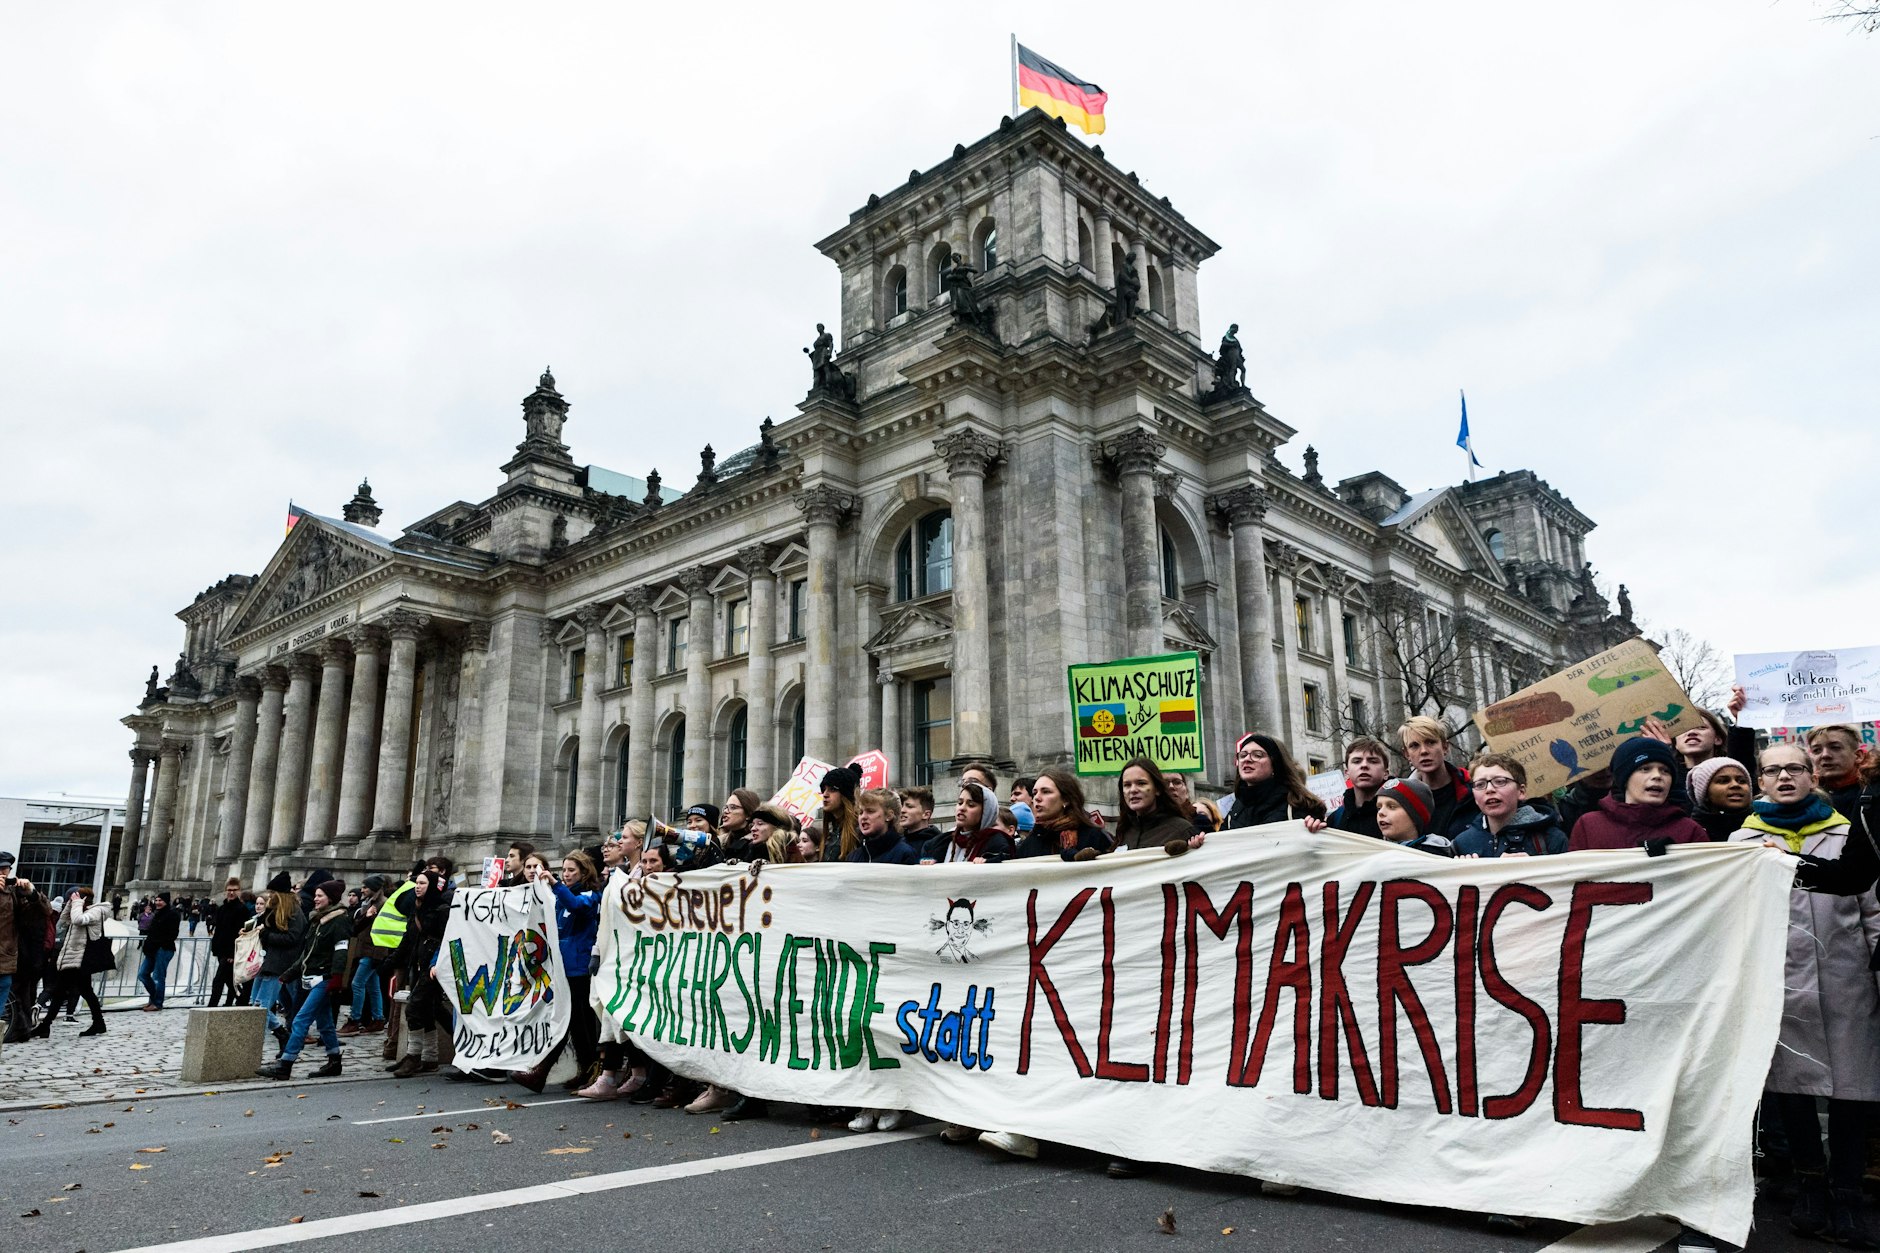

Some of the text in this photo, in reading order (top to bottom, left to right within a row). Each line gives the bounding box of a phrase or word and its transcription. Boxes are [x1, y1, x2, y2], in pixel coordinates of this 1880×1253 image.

[1566, 667, 1585, 681] DER
[1586, 651, 1619, 672] LETZTE
[1787, 670, 1838, 686] Ich kann
[1075, 668, 1195, 703] KLIMASCHUTZ
[1803, 687, 1827, 700] nicht
[1832, 684, 1867, 699] finden
[1127, 701, 1152, 726] ist
[1578, 727, 1615, 749] MERKEN
[1585, 721, 1600, 734] IHR
[1079, 735, 1200, 763] INTERNATIONAL
[1516, 733, 1545, 753] LETZTE
[1600, 741, 1616, 756] MAN
[621, 873, 773, 934] @Scheuer:
[605, 928, 901, 1072] VERKEHRSWENDE
[1016, 878, 1654, 1132] KLIMAKRISE
[896, 983, 996, 1072] statt
